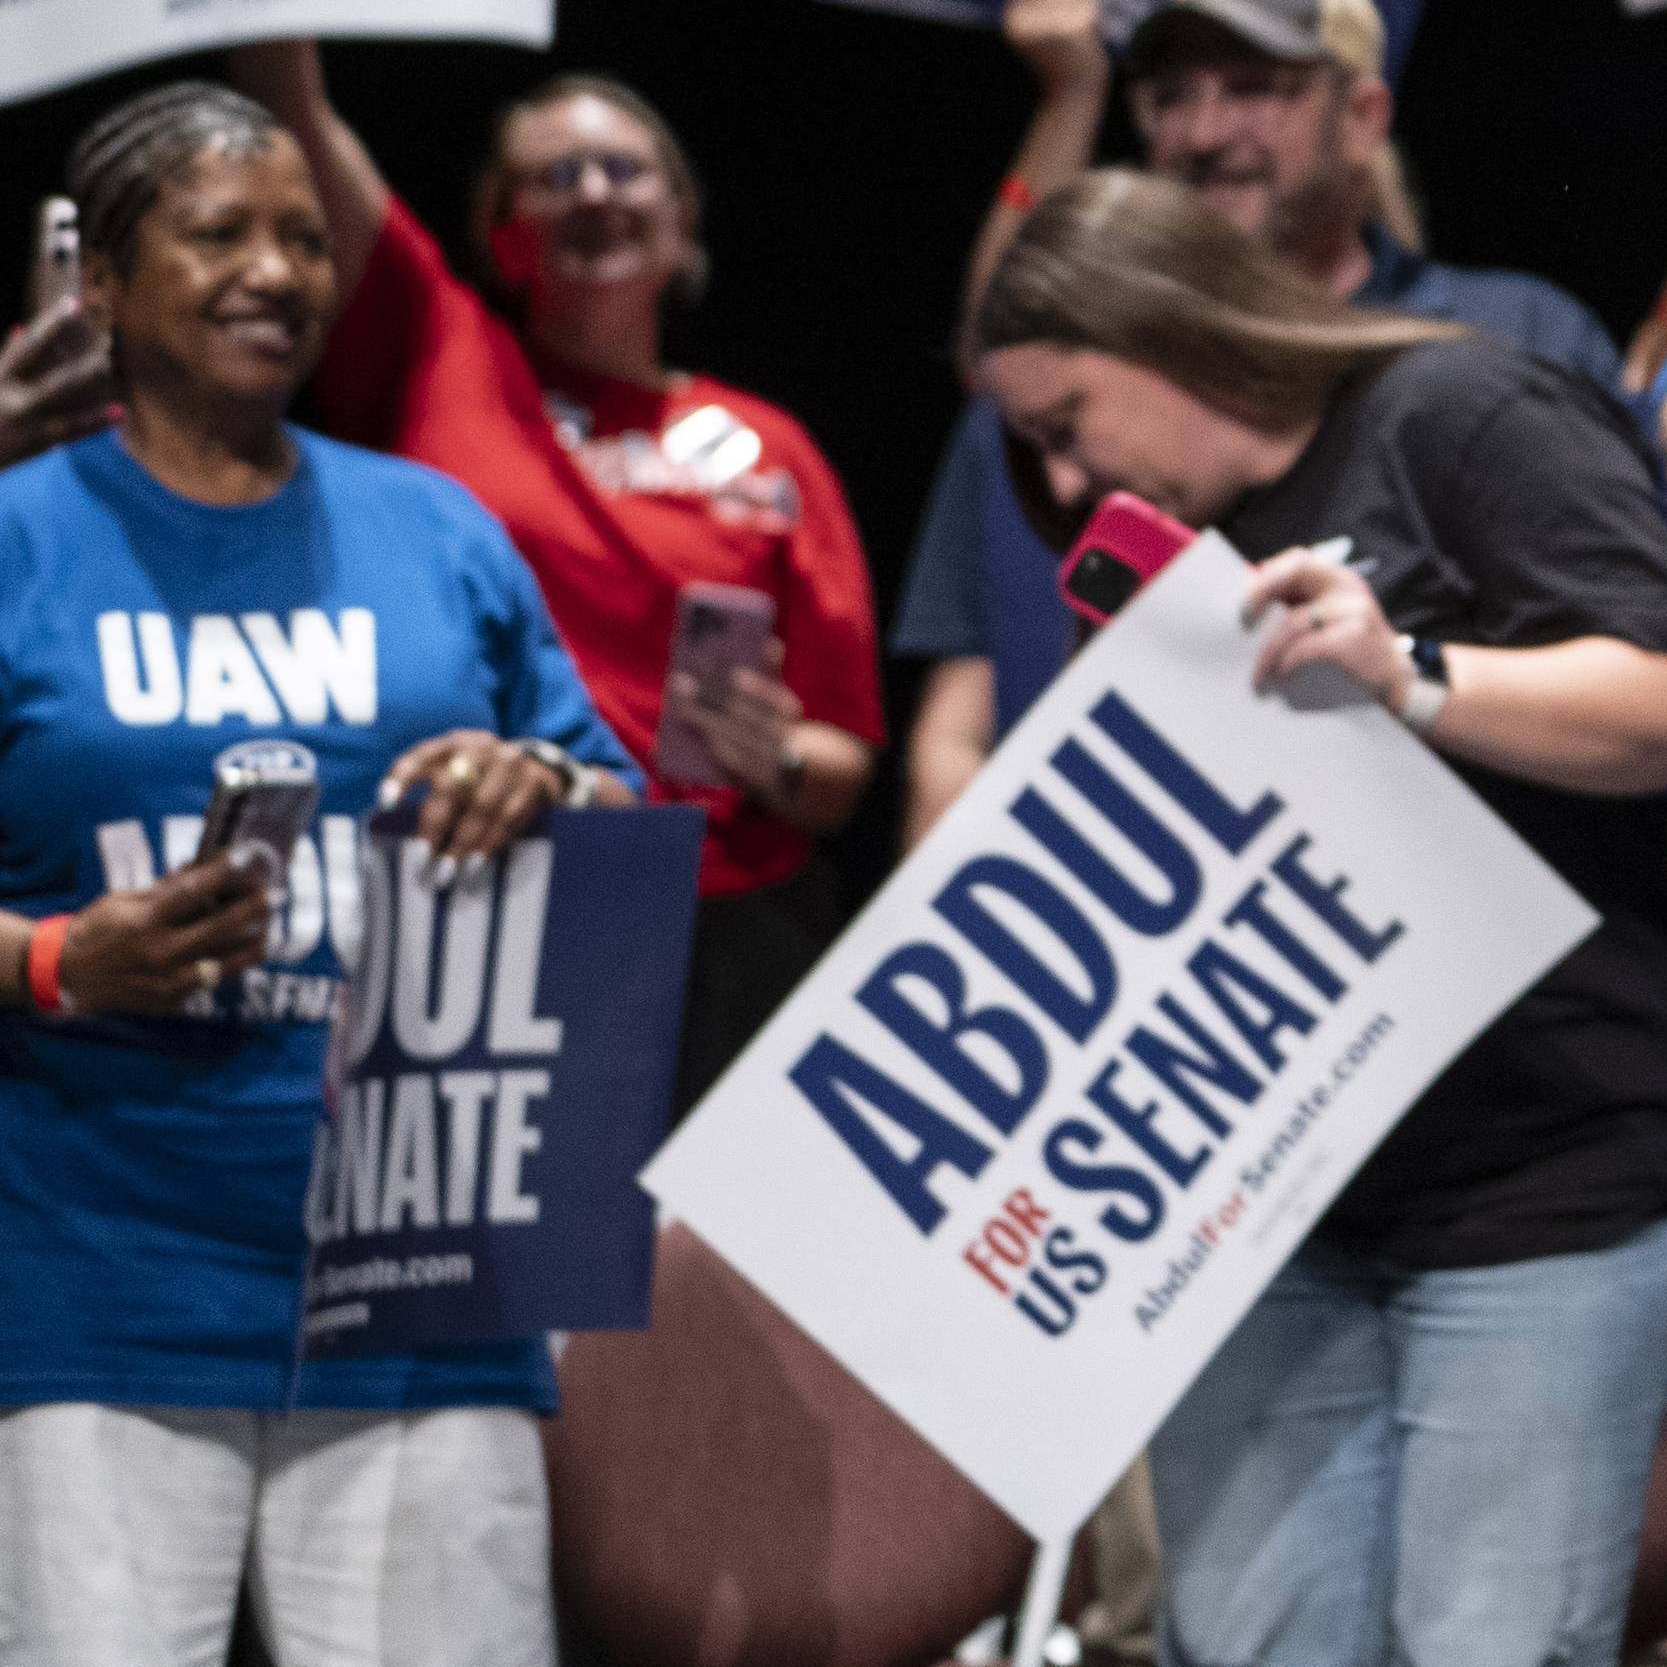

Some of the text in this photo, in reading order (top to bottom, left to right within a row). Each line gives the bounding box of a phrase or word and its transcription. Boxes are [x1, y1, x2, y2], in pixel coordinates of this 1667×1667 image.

[95, 605, 379, 727] UAW
[784, 686, 1287, 1239] ABDUL
[1040, 829, 1407, 1247] SENATE
[302, 1068, 550, 1245] ENATE
[960, 1185, 1052, 1297] FOR
[1131, 1009, 1395, 1334] AbdulForSenate.com
[1011, 1224, 1110, 1339] US
